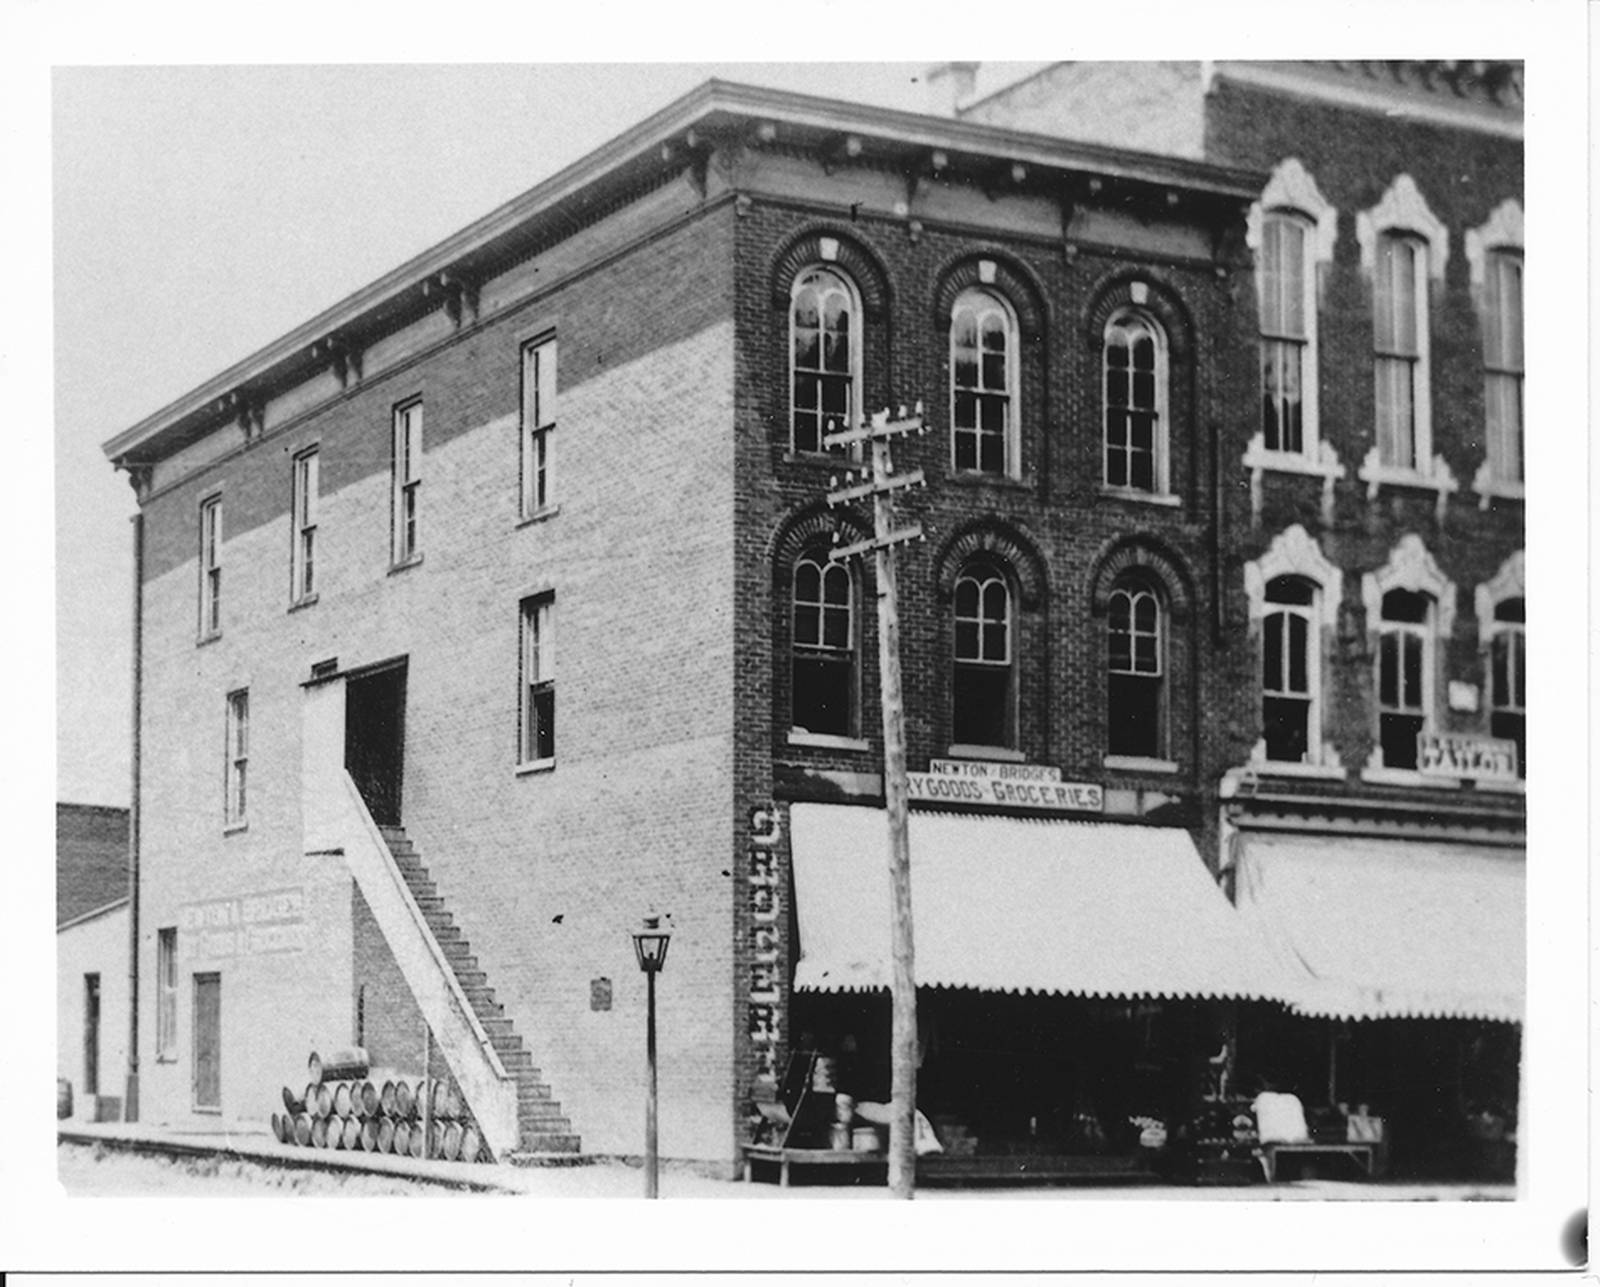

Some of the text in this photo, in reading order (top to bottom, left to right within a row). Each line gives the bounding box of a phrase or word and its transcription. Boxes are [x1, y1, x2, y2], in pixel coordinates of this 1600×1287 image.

[932, 762, 988, 778] NEWTON
[926, 777, 983, 799] GOODS
[991, 780, 1101, 807] GROCERIES
